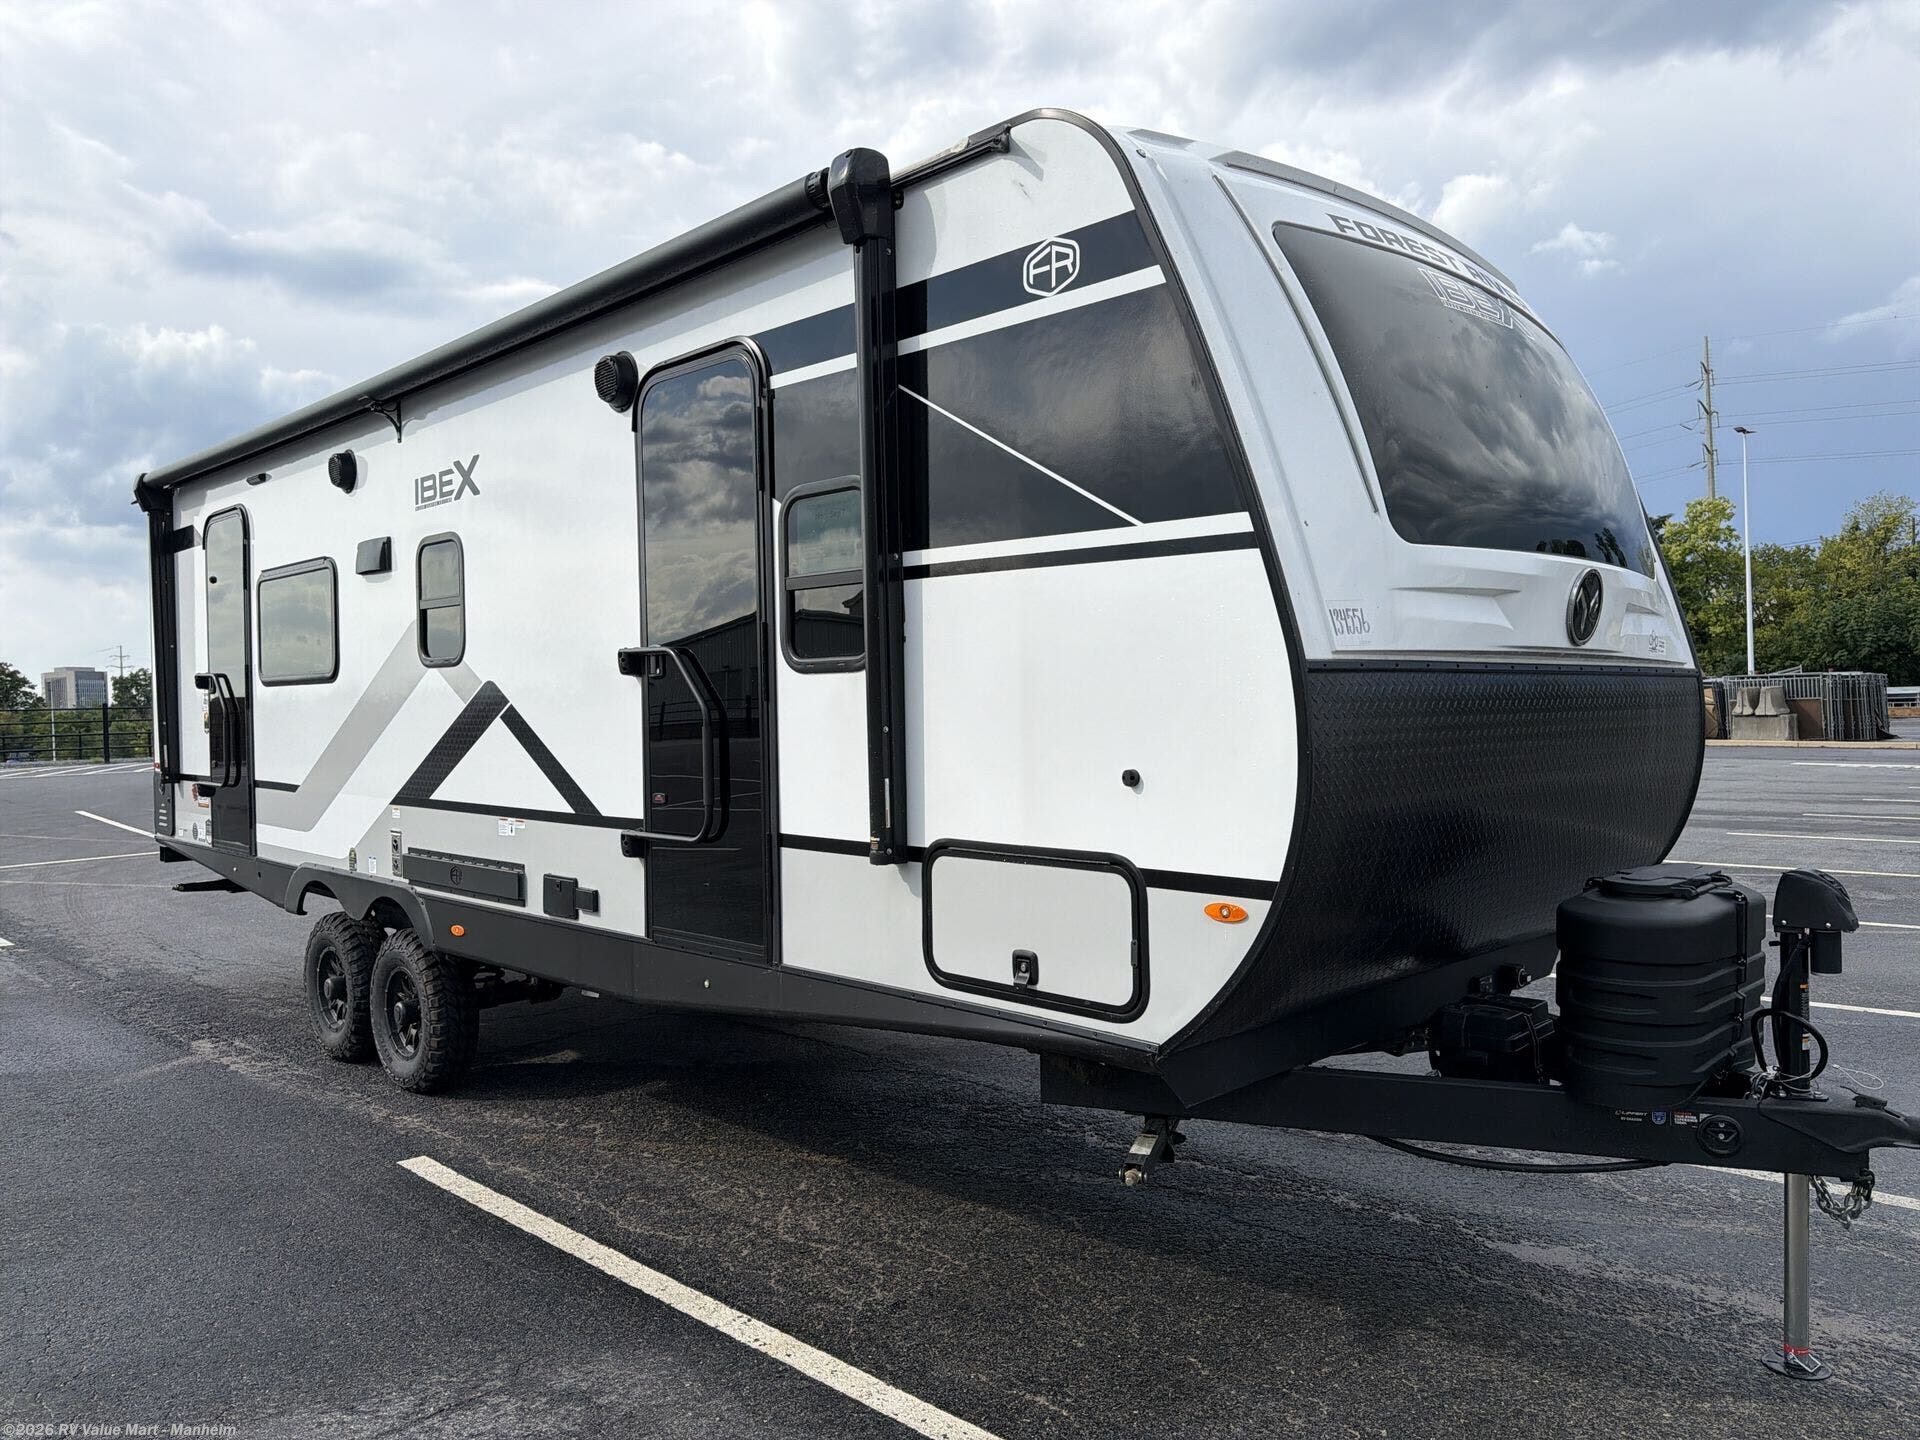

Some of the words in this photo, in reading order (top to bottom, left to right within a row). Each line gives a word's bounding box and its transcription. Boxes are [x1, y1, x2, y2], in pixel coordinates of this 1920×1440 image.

[1326, 213, 1462, 272] FOREST
[414, 454, 481, 502] IBEX
[1328, 607, 1371, 636] 134556
